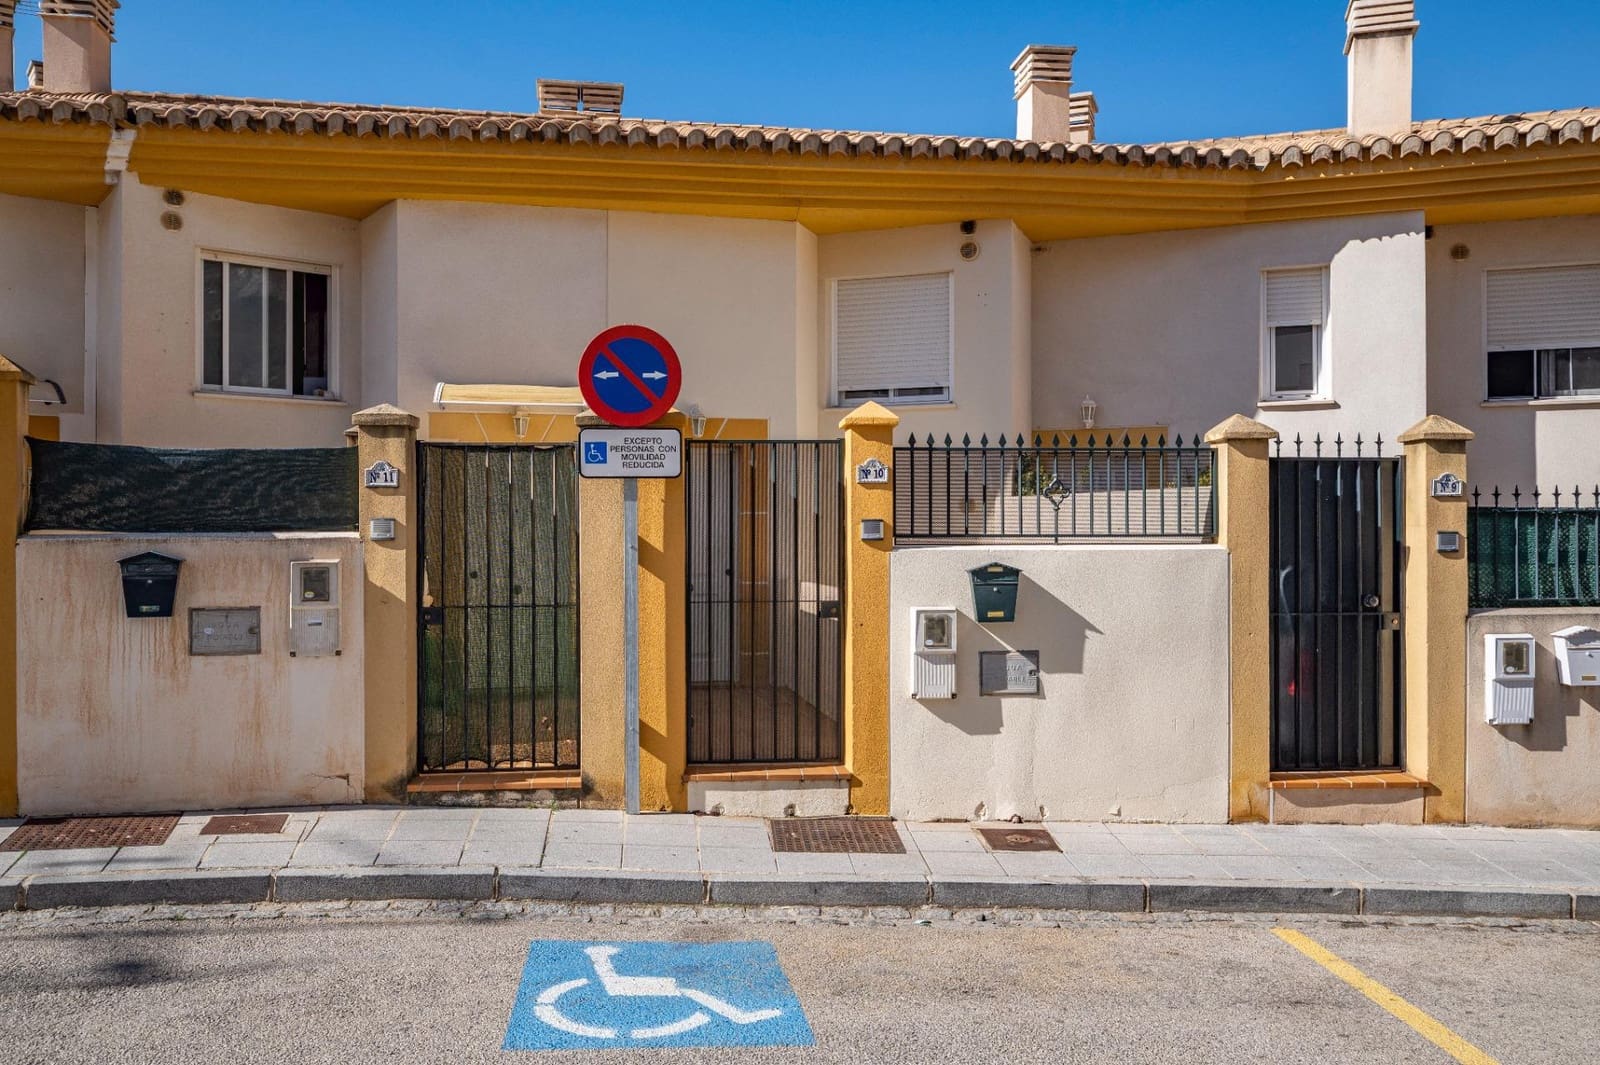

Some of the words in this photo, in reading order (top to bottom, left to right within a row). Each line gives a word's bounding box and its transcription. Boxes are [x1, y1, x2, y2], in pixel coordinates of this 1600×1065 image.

[623, 437, 663, 445] EXCEPTO
[610, 445, 655, 453] PERSONAS
[658, 445, 677, 453] CON
[621, 453, 666, 461] MOVILIDAD
[622, 461, 665, 469] REDUCIDA
[384, 472, 394, 482] 11
[874, 468, 884, 478] 10
